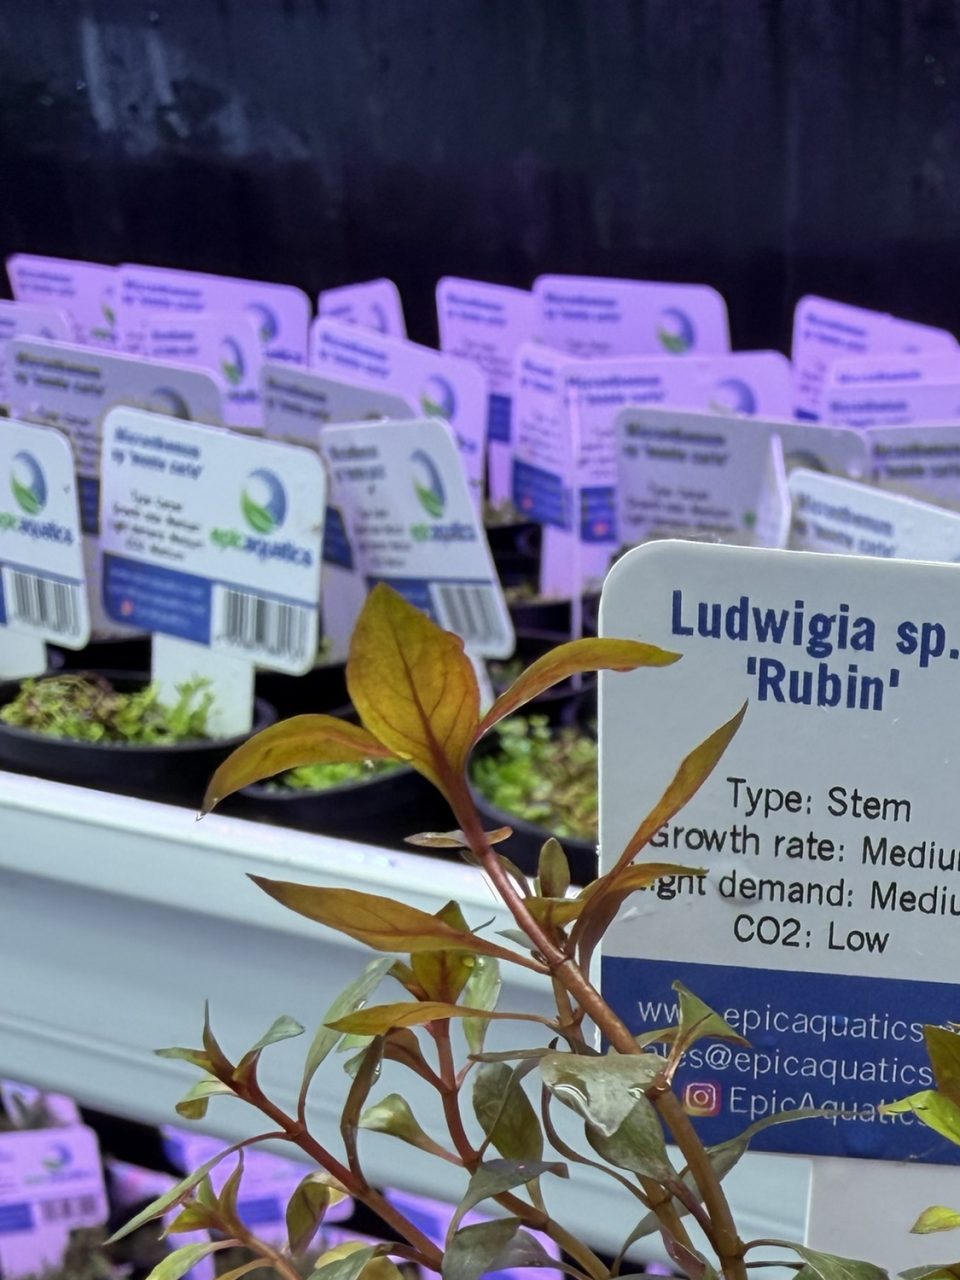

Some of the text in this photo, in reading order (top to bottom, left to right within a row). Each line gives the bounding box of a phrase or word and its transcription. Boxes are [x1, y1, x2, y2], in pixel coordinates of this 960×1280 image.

[671, 589, 960, 668] Ludwigia sp.
[746, 656, 900, 711] 'Rubin'
[726, 776, 912, 823] Type: Stem
[649, 821, 760, 856] Growth
[774, 832, 845, 863] rate:
[634, 864, 707, 901] ght
[718, 868, 853, 908] demand:
[733, 913, 891, 954] CO2: Low
